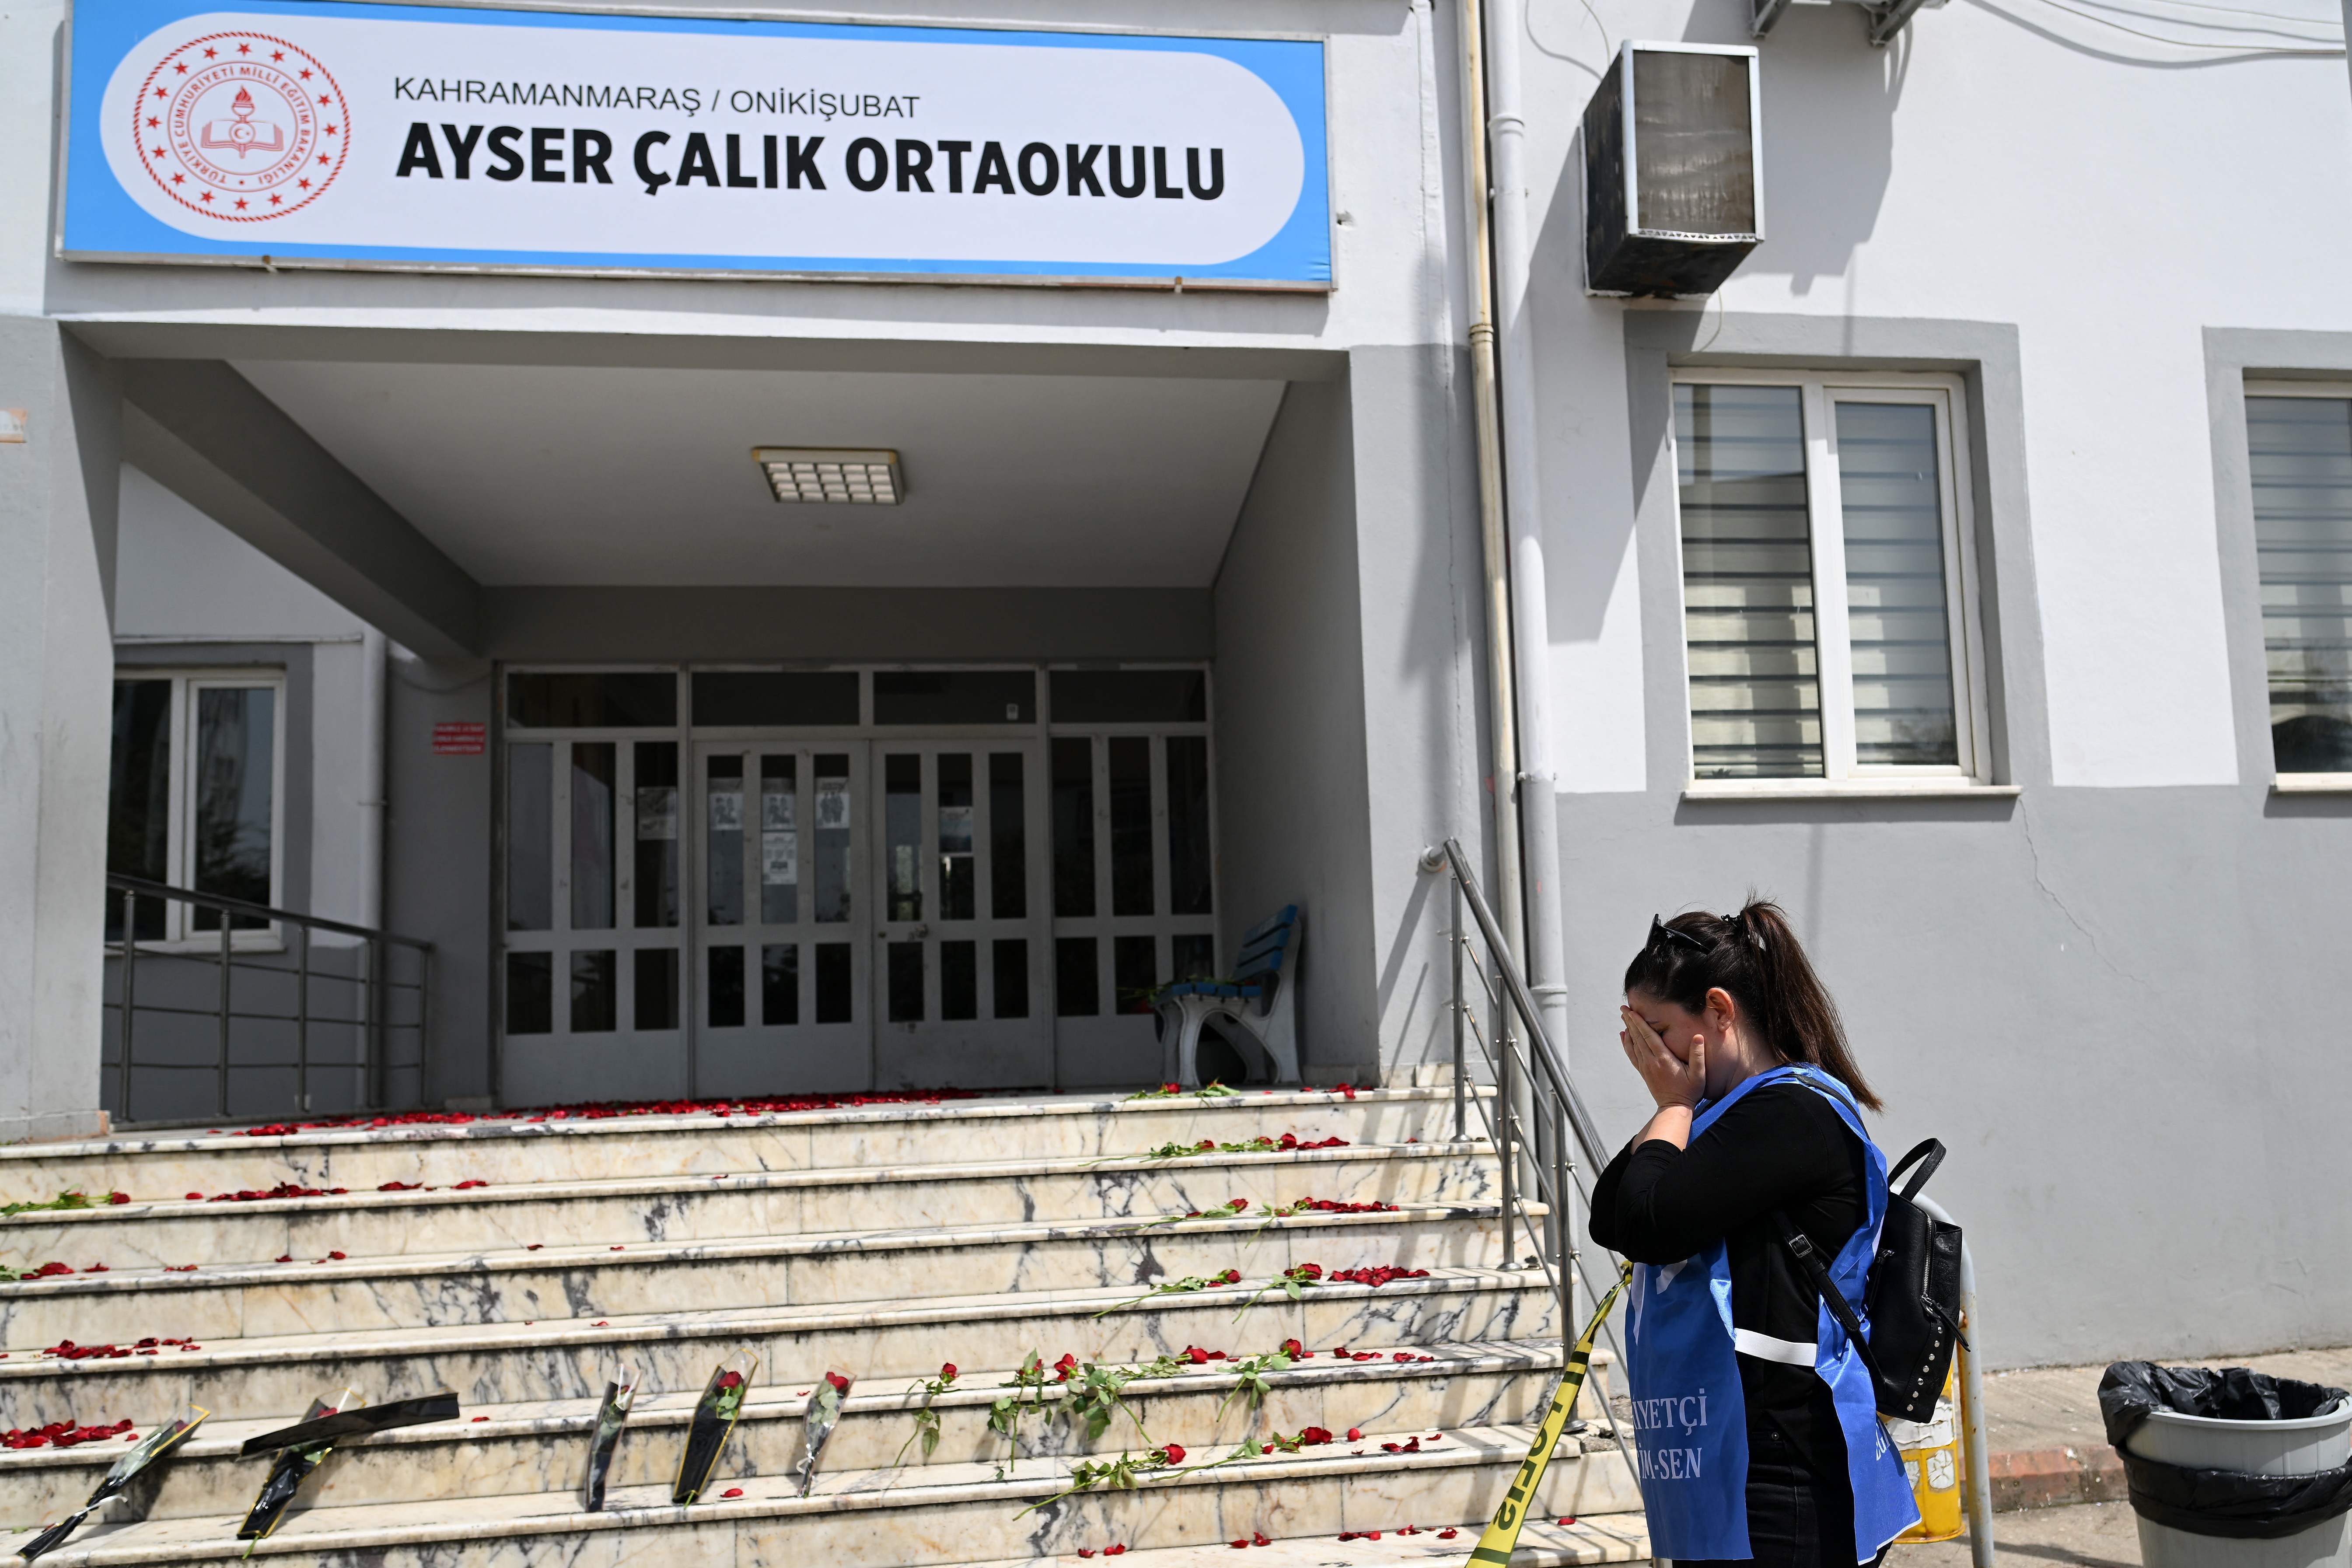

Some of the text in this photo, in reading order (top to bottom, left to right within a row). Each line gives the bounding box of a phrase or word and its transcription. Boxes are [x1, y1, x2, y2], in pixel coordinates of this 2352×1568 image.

[396, 77, 920, 122] KAHRAMANMARAŞ / ONİKİŞUBAT
[396, 122, 1224, 200] AYSER ÇALIK ORTAOKULU
[1637, 1442, 1702, 1480] İM-SEN
